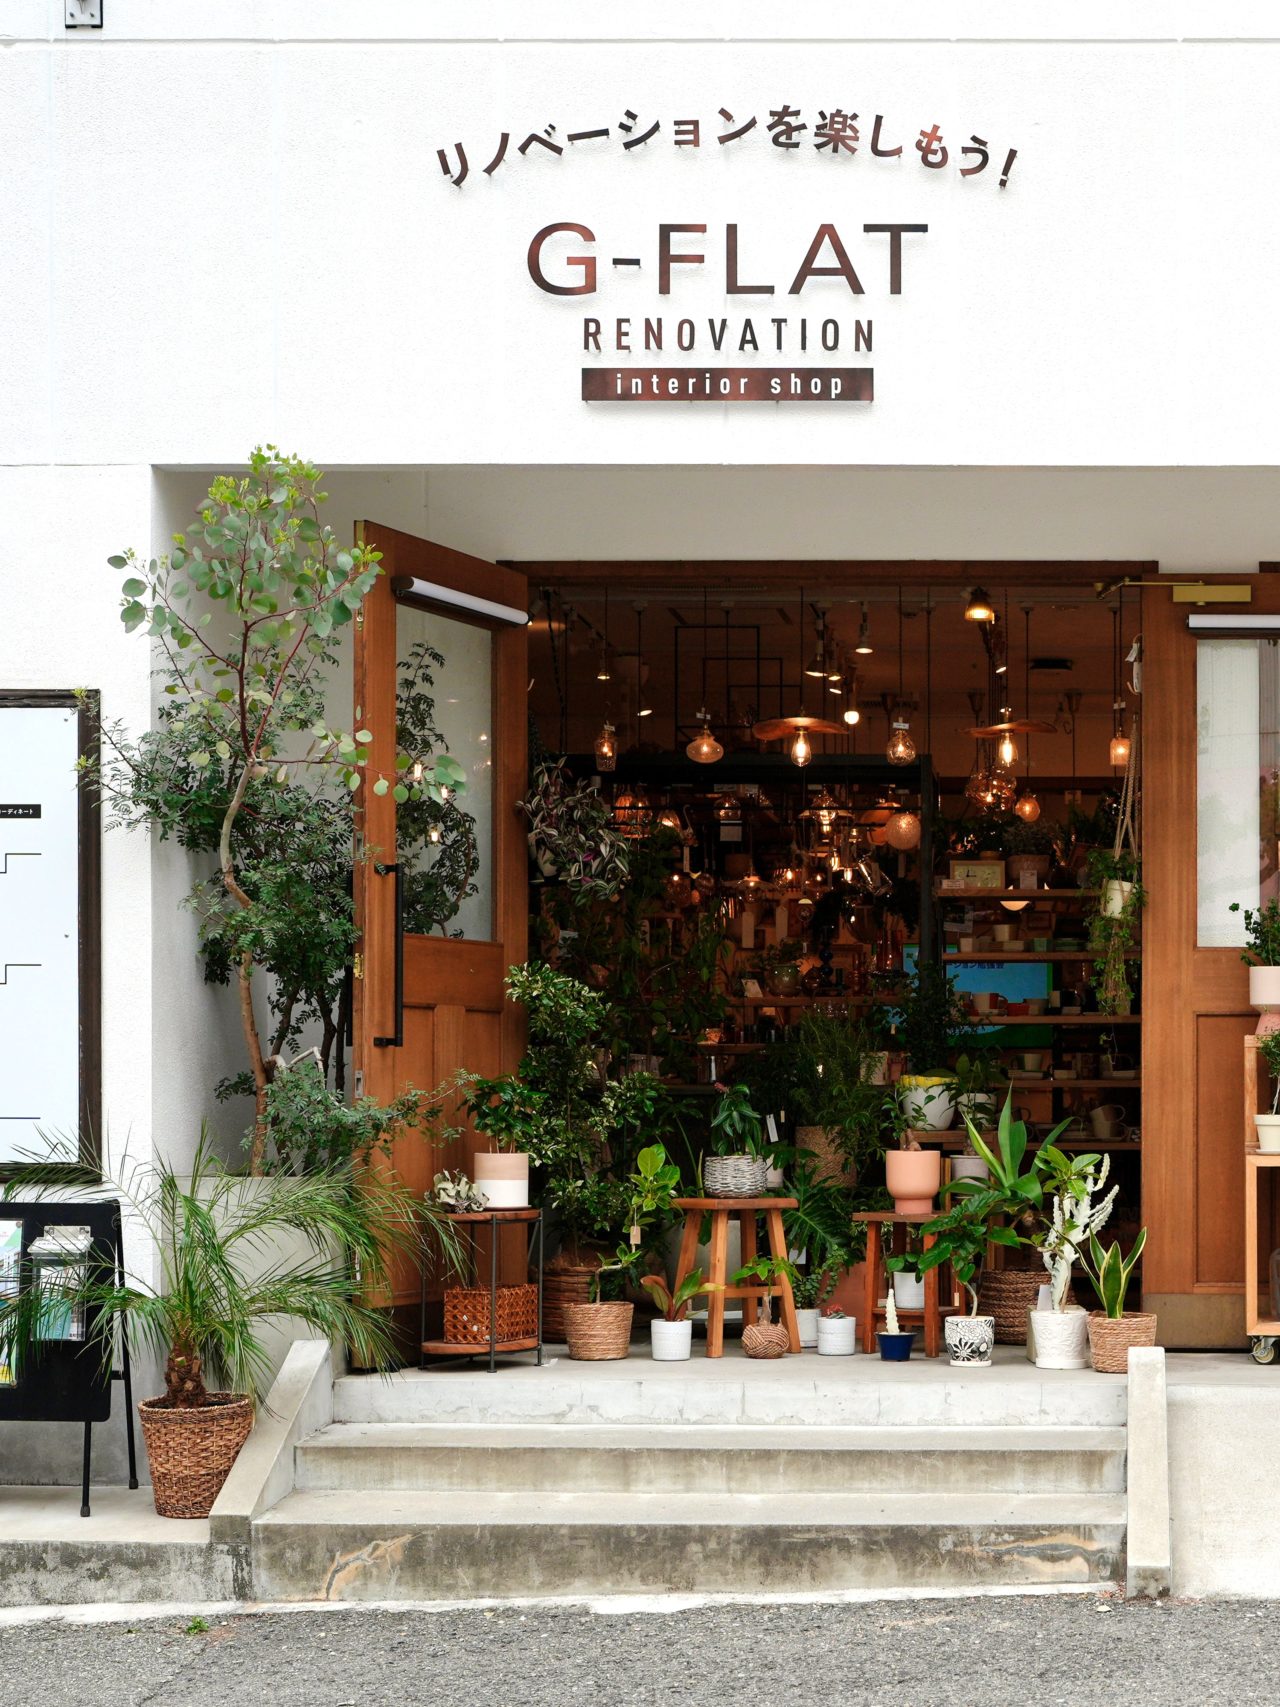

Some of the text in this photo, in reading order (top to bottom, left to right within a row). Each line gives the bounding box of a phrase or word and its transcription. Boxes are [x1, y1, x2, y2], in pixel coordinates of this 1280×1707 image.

[437, 105, 1017, 187] リノベーションを楽しもう!
[527, 222, 929, 295] G-FLAT
[584, 318, 873, 351] RENOVATION
[616, 373, 844, 397] interior shop
